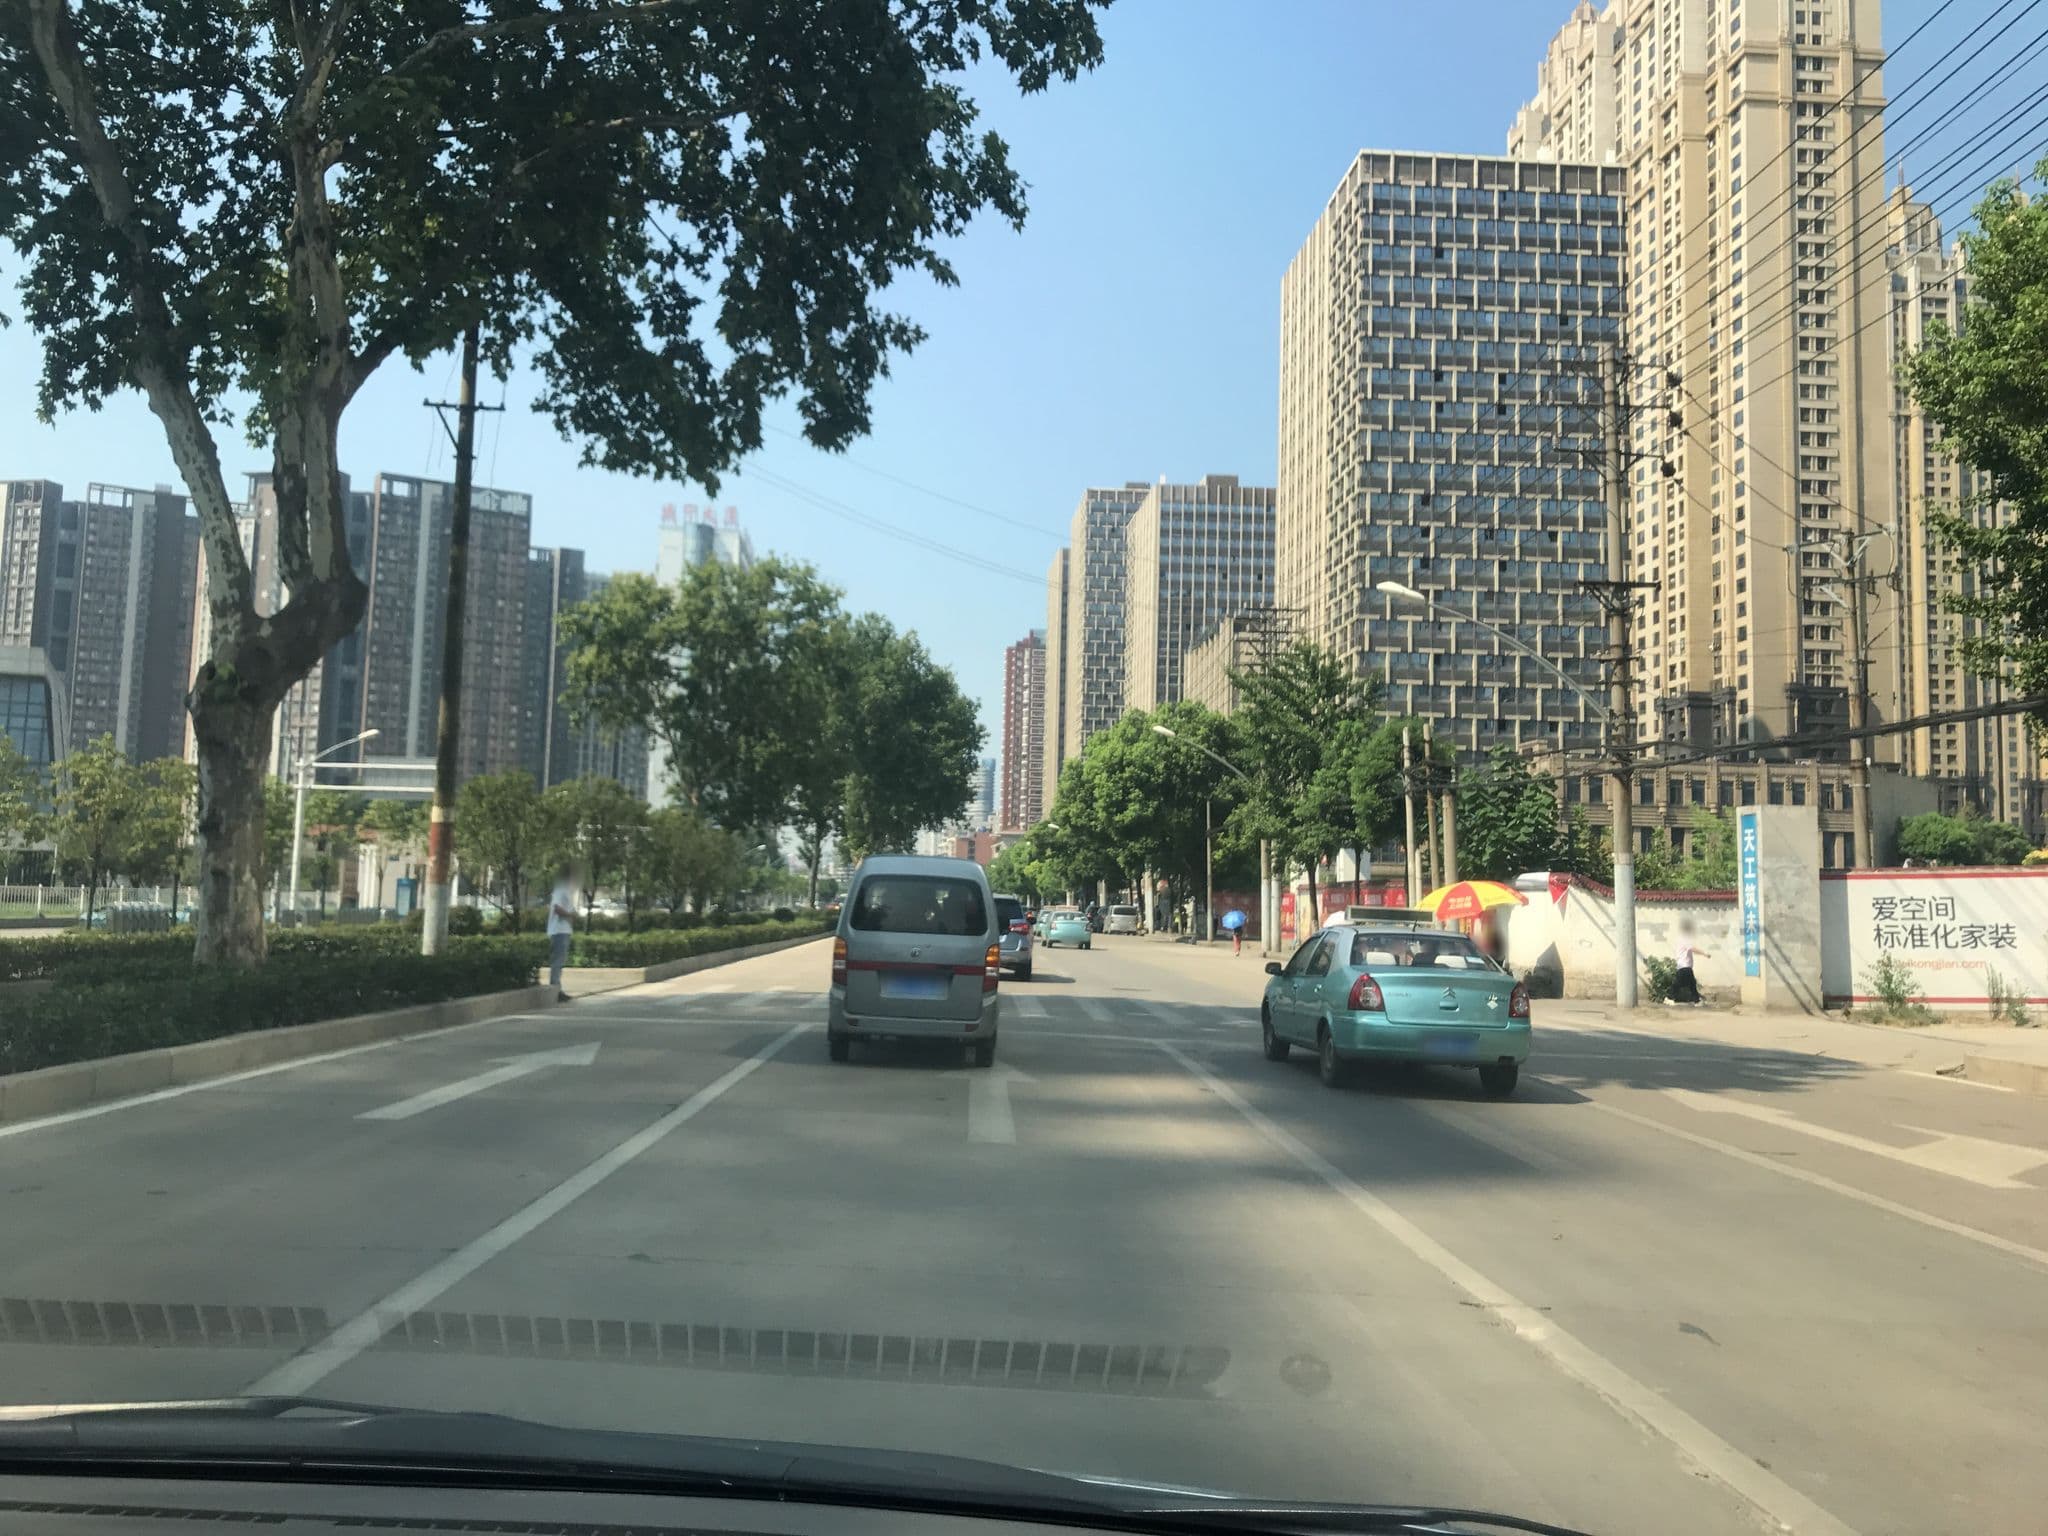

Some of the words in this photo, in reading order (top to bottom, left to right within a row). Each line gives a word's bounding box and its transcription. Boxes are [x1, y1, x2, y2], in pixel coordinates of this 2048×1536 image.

[1872, 896, 1956, 921] 爱空间
[1873, 923, 2018, 950] 标准化家装
